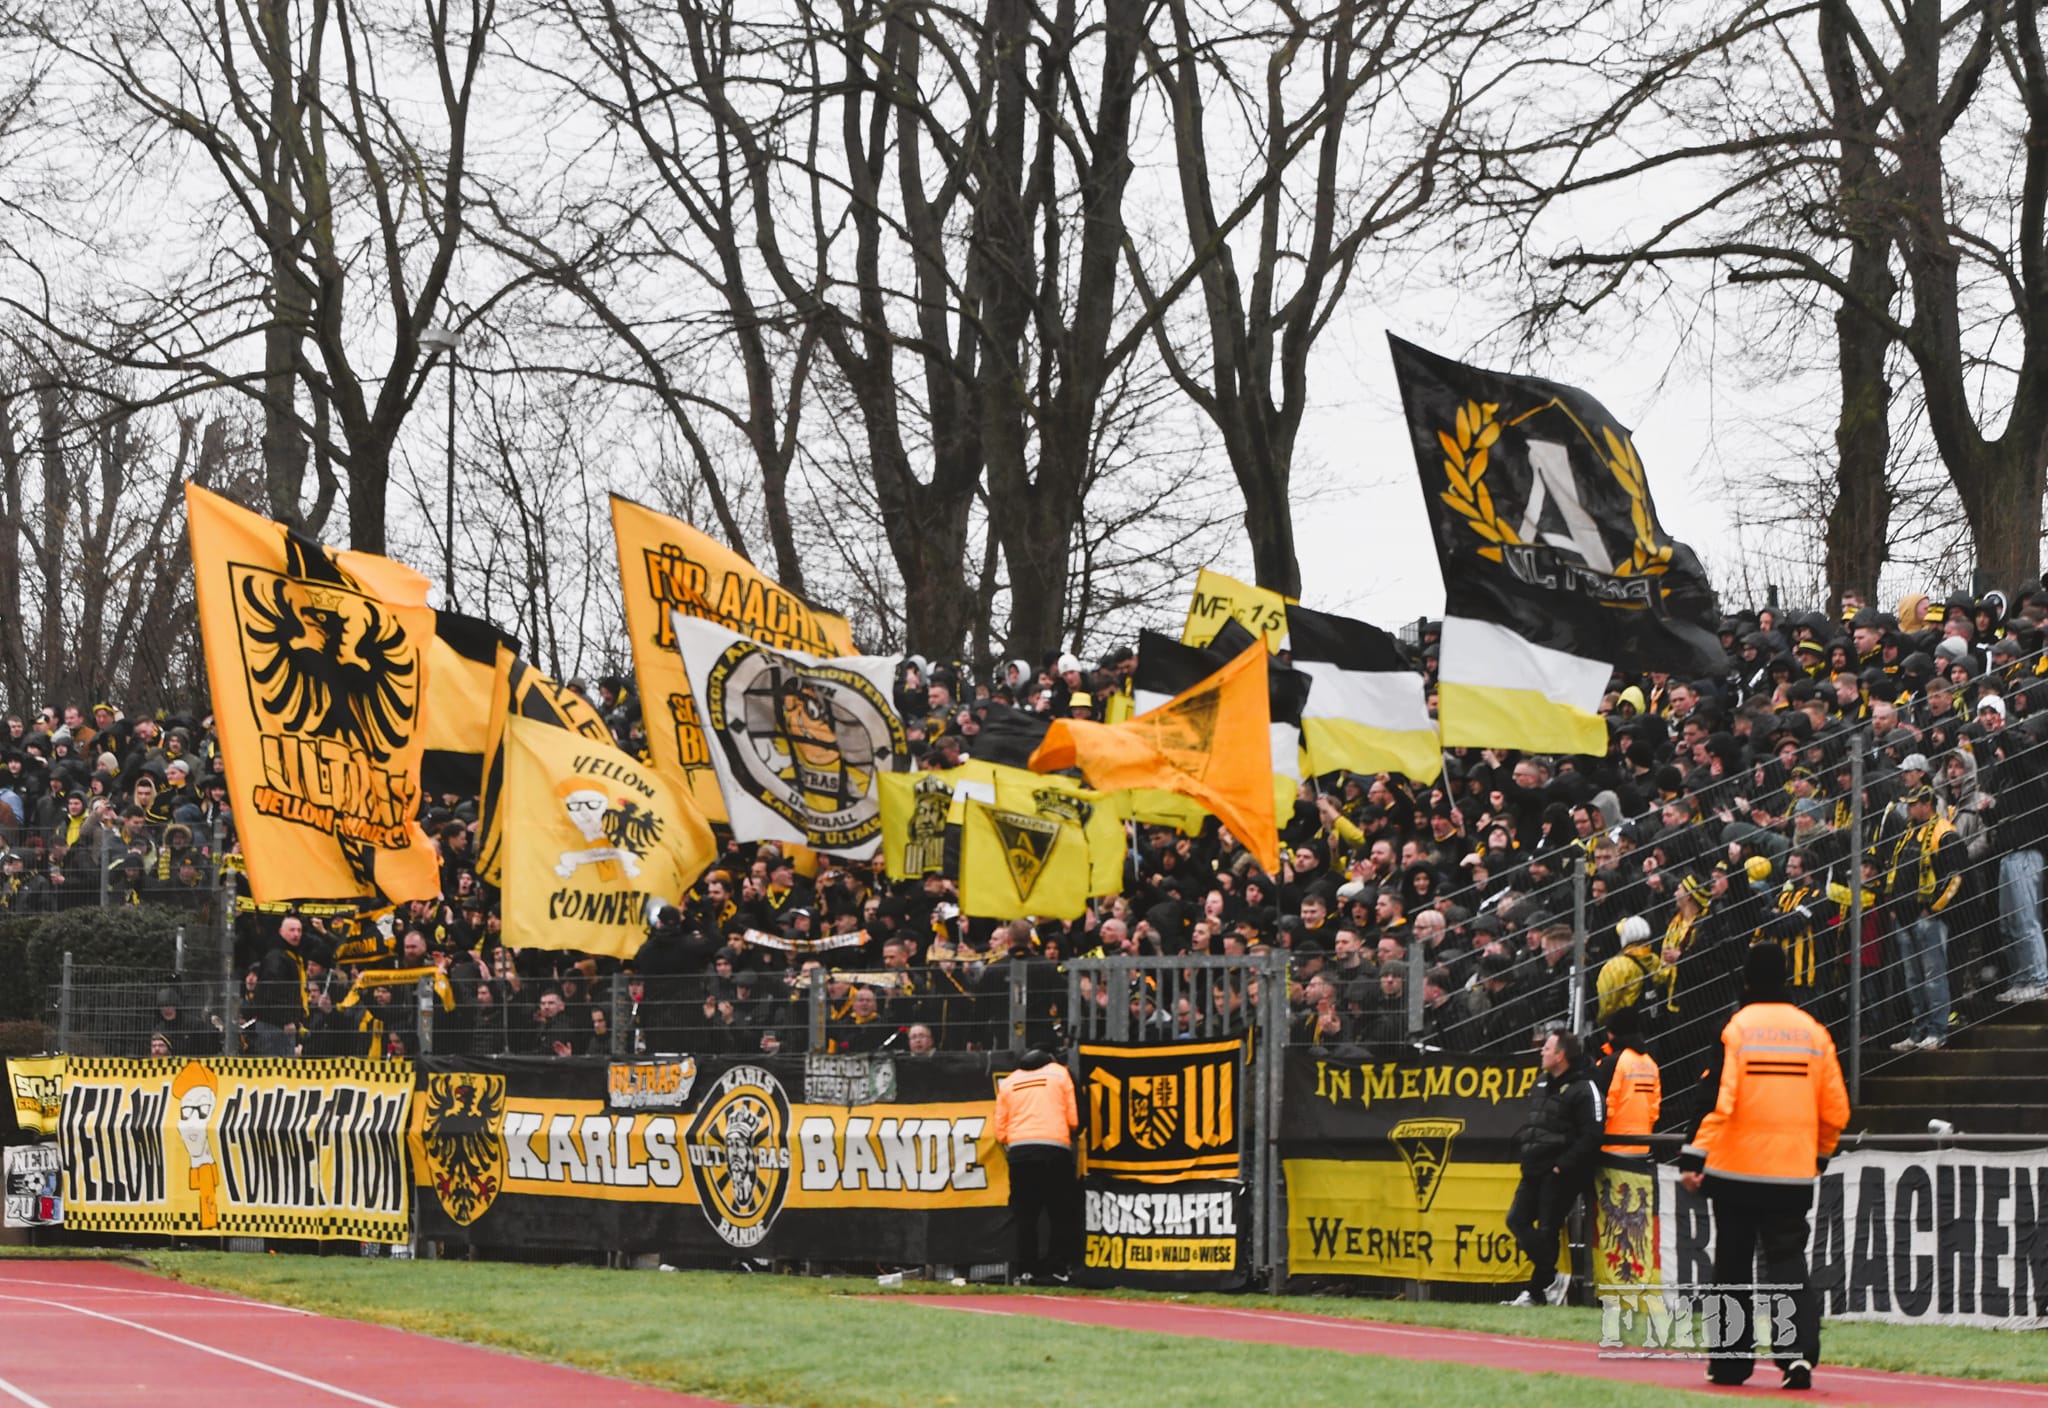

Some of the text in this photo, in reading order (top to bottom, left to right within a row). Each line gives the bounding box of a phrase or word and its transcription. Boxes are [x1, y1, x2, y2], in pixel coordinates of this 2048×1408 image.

[643, 543, 710, 606] FÜR
[573, 755, 656, 798] YELLOW
[253, 785, 335, 836] YELLOW
[721, 1068, 776, 1095] KARLS
[1360, 1063, 1539, 1109] MEMORIA
[12, 1150, 59, 1172] NEIN
[60, 1085, 408, 1212] YELLOW CONNECTION
[502, 1111, 684, 1187] KARLS
[688, 1144, 790, 1169] ULT RAS
[800, 1117, 987, 1192] BANDE
[1413, 1141, 1435, 1161] A
[7, 1197, 34, 1218] ZU
[1085, 1190, 1237, 1236] BOXSTAFFEL
[718, 1217, 766, 1245] BANDE
[1085, 1234, 1231, 1270] 520 FELD WALD WIESE
[1307, 1217, 1434, 1269] WERNER
[1809, 1165, 2048, 1317] AACHEN
